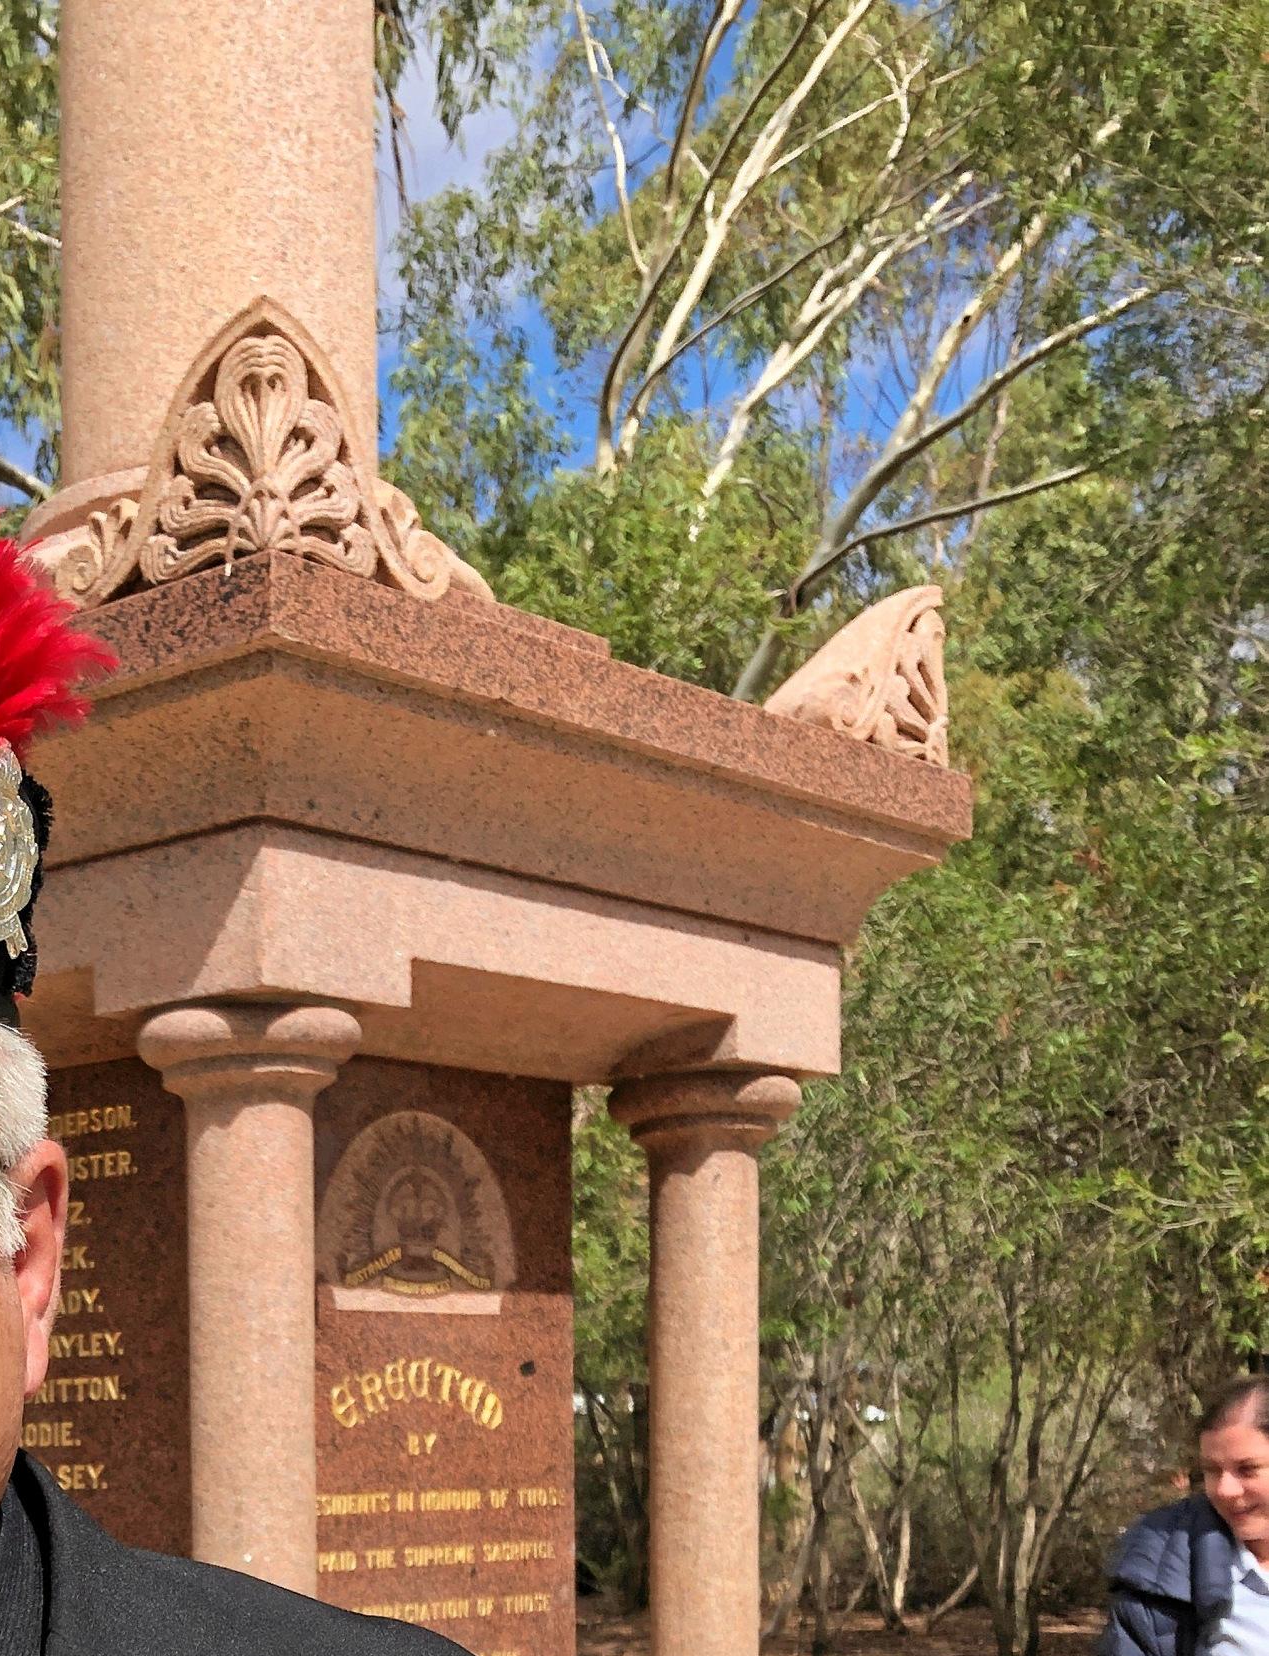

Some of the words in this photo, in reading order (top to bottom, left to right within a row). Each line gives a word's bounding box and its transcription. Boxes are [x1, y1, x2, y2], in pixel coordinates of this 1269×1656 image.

[19, 1421, 82, 1448] ODIE.
[407, 1431, 437, 1456] BY
[396, 1490, 415, 1513] IN
[489, 1487, 509, 1509] OF
[317, 1549, 358, 1574] PAID
[364, 1546, 398, 1570] THE
[403, 1544, 476, 1568] SUPREME
[352, 1598, 470, 1623] PRECIATION
[475, 1597, 496, 1618] OF
